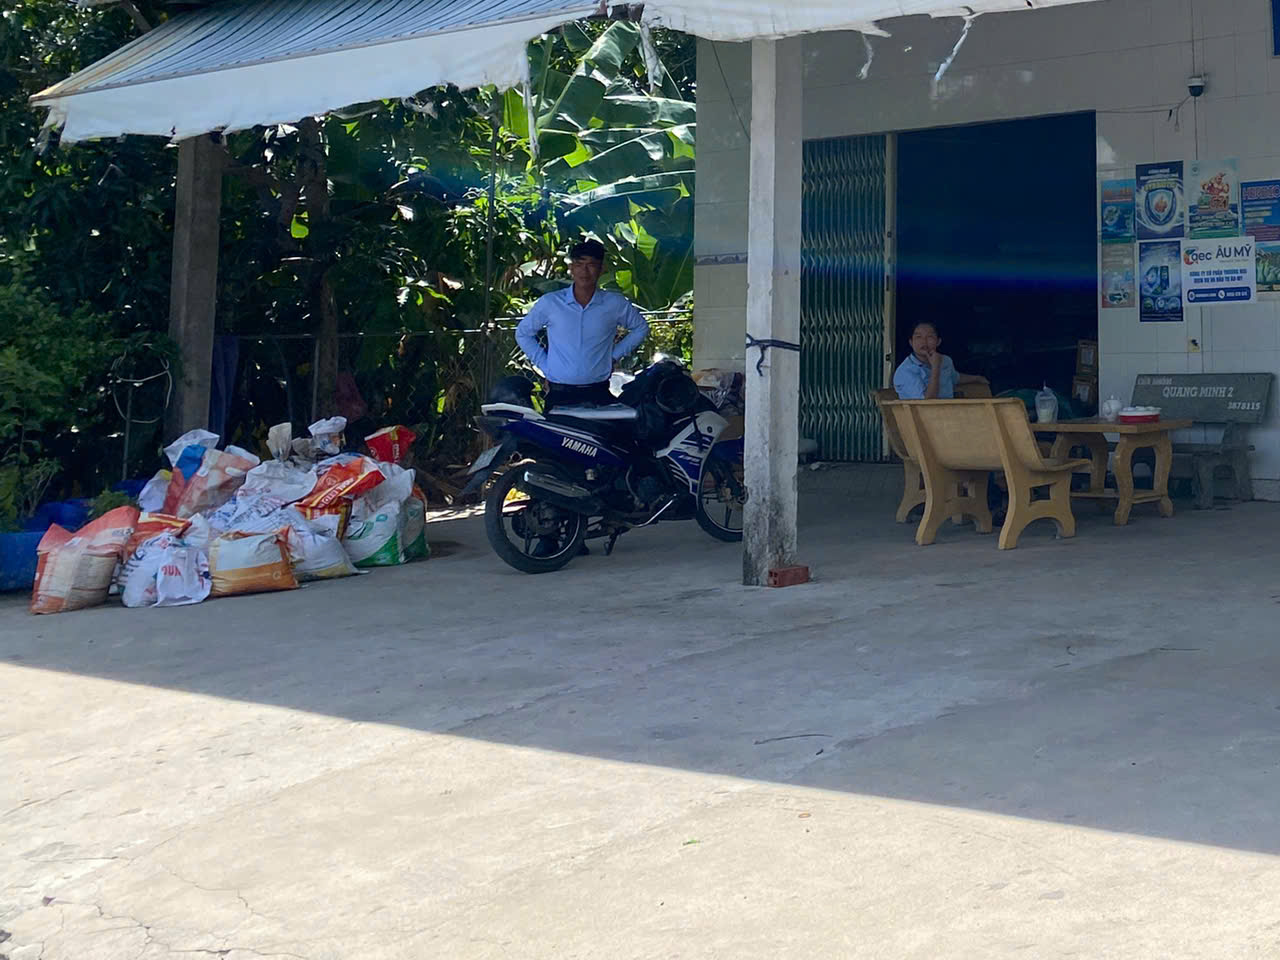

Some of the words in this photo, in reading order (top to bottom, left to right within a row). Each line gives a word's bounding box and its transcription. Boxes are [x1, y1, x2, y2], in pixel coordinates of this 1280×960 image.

[1191, 251, 1212, 262] aec
[1215, 244, 1232, 259] ÂU
[1234, 243, 1252, 257] MỸ
[1163, 386, 1198, 398] QUANG
[1199, 386, 1226, 398] MINH
[1227, 386, 1234, 398] 2
[561, 437, 598, 457] YAMAHA
